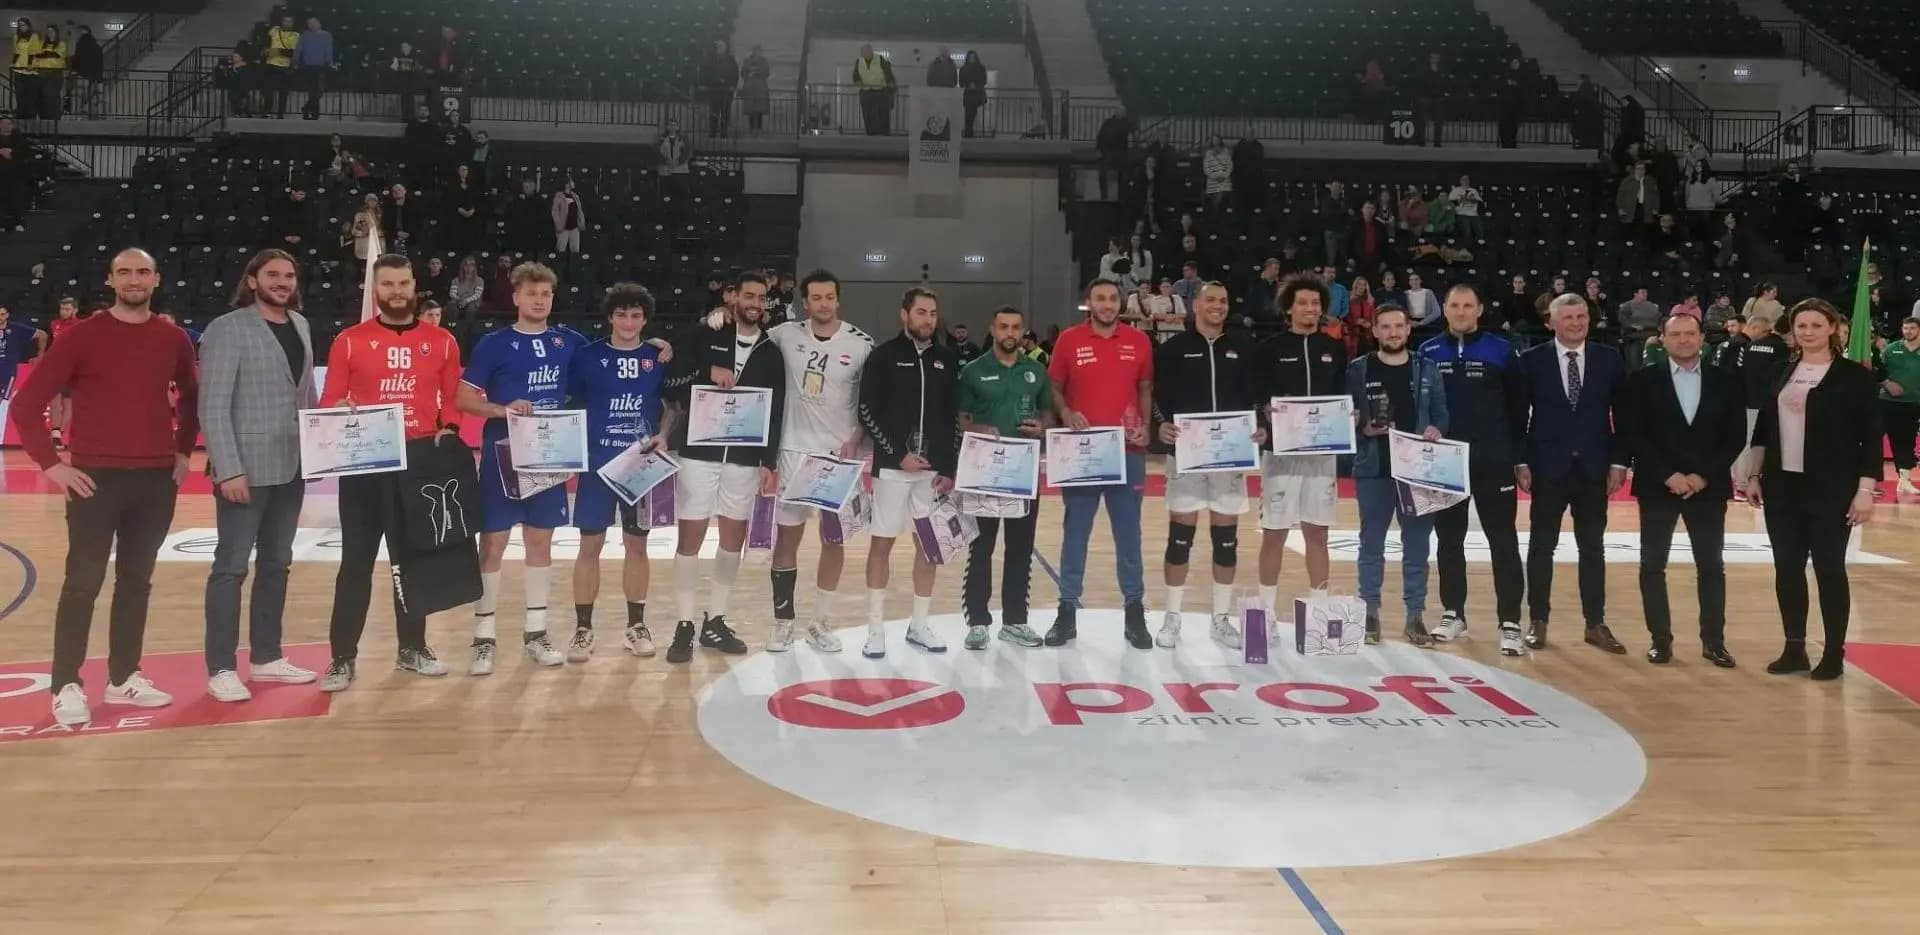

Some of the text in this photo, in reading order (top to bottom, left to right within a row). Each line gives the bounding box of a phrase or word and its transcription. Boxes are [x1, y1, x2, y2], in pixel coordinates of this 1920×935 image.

[1390, 120, 1415, 139] 10
[387, 346, 412, 369] 96
[532, 339, 546, 357] 9
[617, 358, 639, 379] 39
[807, 351, 829, 372] 24
[380, 373, 417, 392] niké
[527, 365, 560, 385] niké
[609, 393, 643, 410] niké
[1032, 675, 1540, 726] profi
[1132, 715, 1261, 728] zilnic
[1458, 717, 1561, 729] mici
